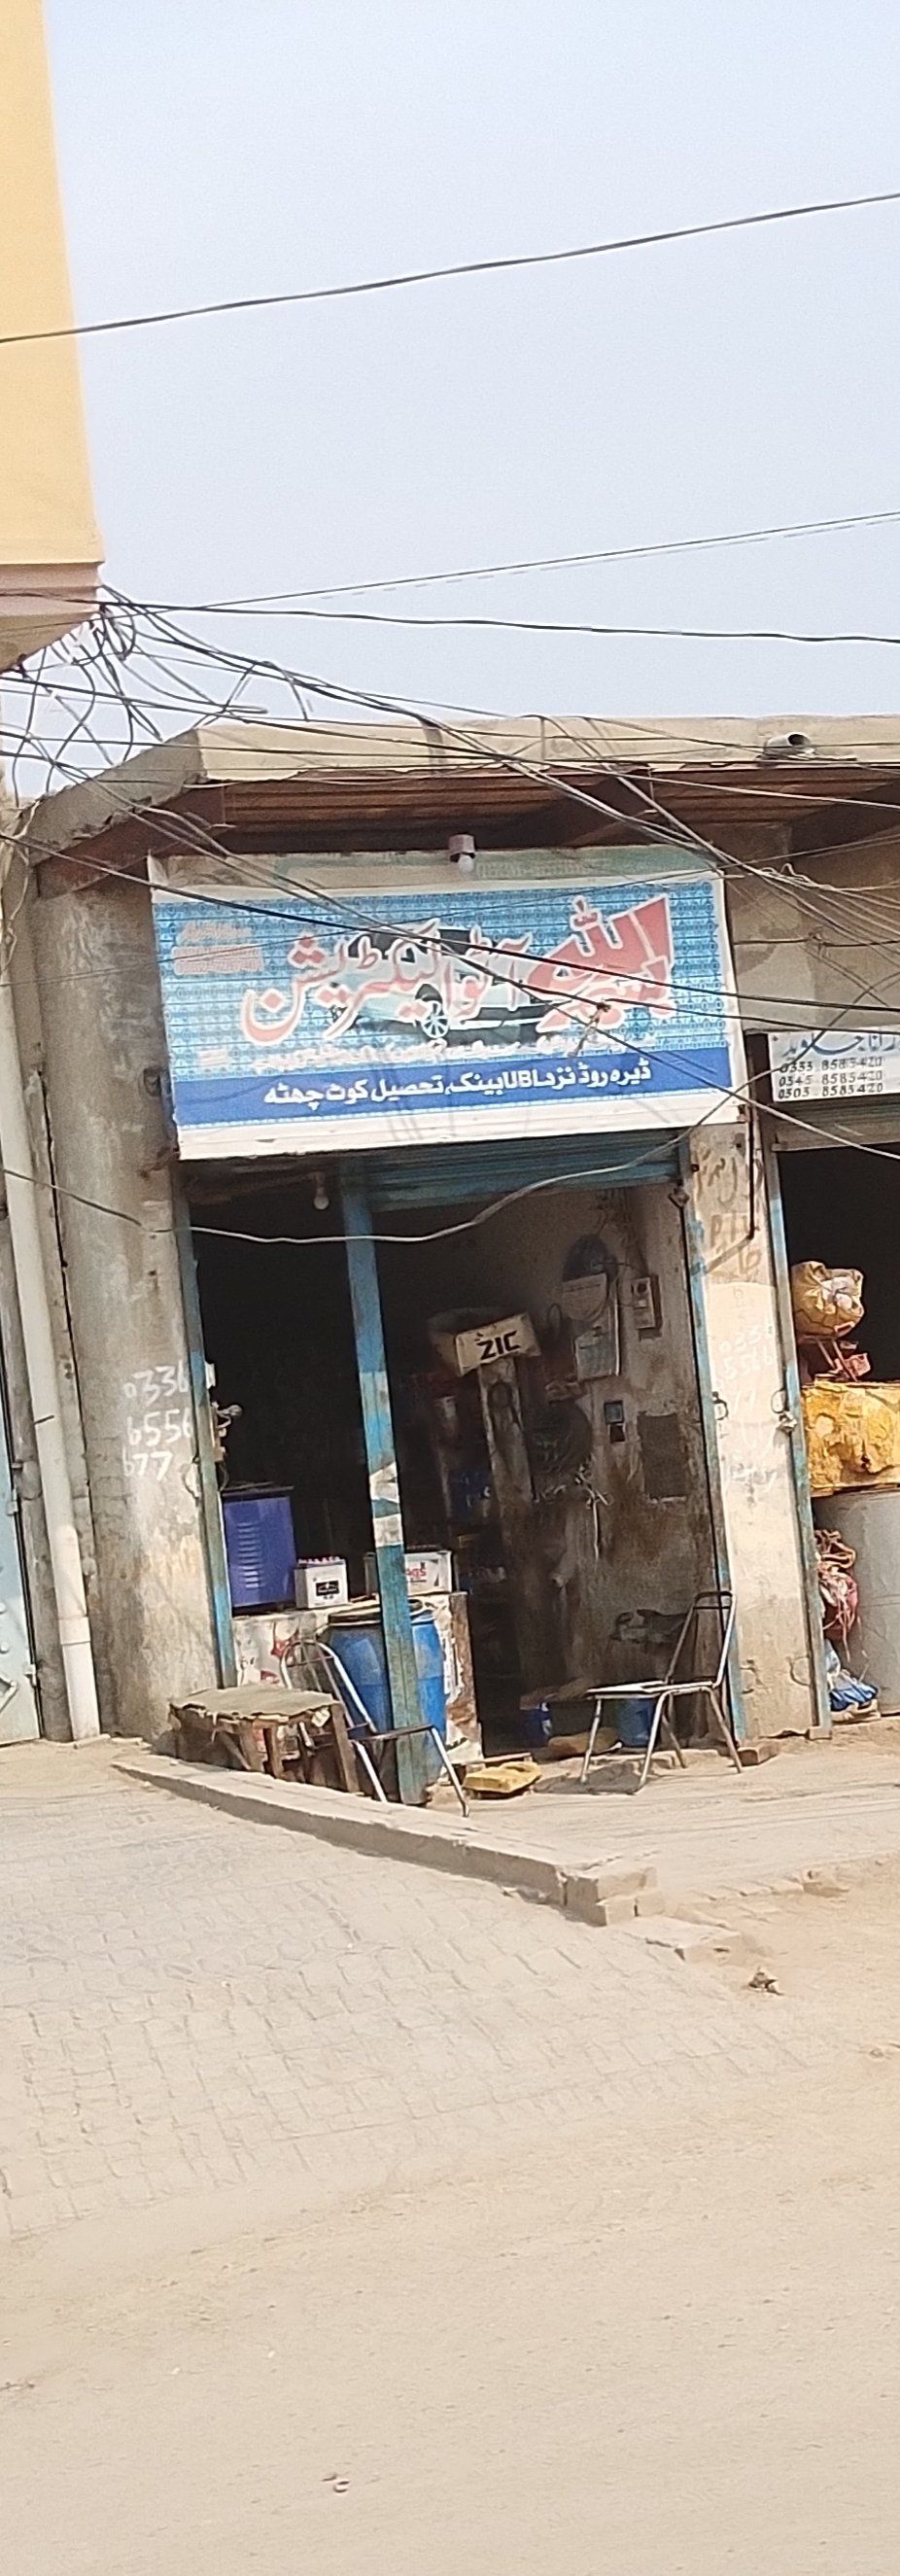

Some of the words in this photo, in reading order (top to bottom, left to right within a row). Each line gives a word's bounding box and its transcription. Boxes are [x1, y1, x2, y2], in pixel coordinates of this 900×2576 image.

[502, 1068, 546, 1089] UBL
[544, 1065, 576, 1091] نزد
[577, 1062, 609, 1088] روڈ
[609, 1057, 651, 1087] ڈیرہ
[263, 1082, 325, 1111] چھٹہ
[326, 1079, 368, 1105] کوٹ
[370, 1074, 444, 1102] تحصیل
[476, 1330, 521, 1361] ZIC
[122, 1359, 190, 1407] 0336
[127, 1407, 193, 1446] 6556
[121, 1443, 173, 1481] 677
